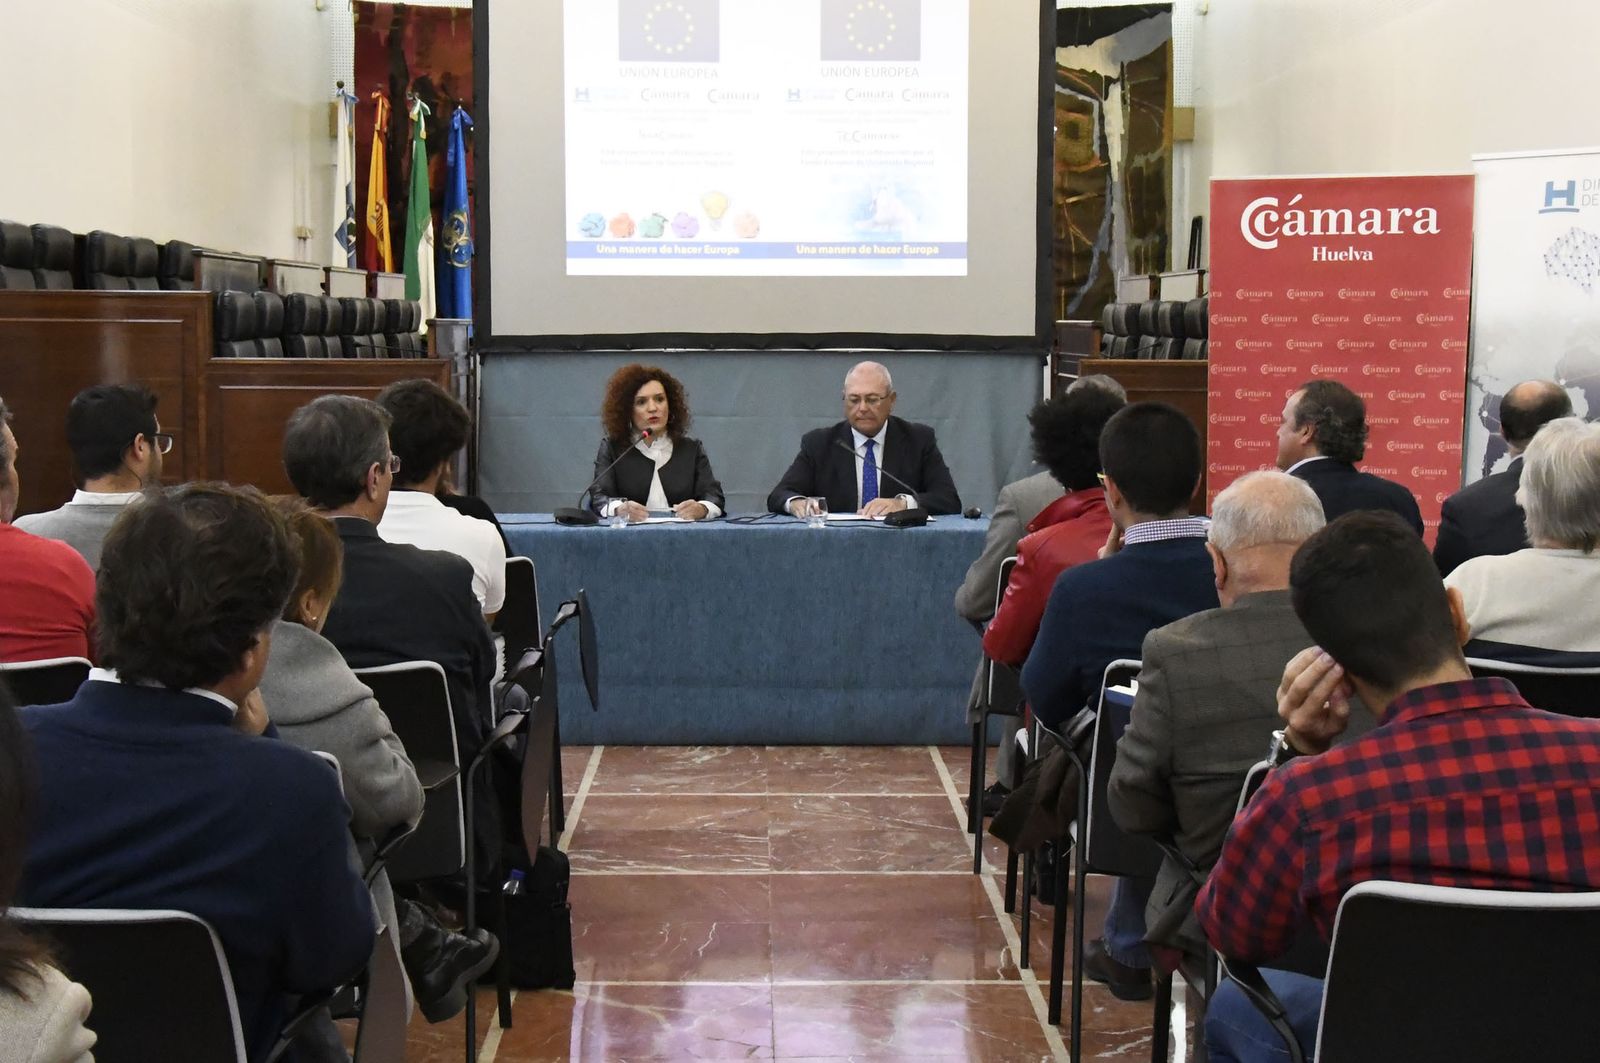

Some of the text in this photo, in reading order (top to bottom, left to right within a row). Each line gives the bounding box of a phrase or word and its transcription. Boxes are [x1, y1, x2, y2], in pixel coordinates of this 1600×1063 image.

[663, 67, 719, 79] EUROPEA
[820, 65, 920, 77] UNIÓN EUROPEA
[1582, 178, 1600, 191] DI
[597, 244, 617, 253] Una
[659, 244, 672, 253] de
[673, 244, 702, 253] hacer
[703, 244, 740, 255] Europa
[796, 244, 816, 253] Una
[859, 244, 872, 253] de
[873, 244, 901, 253] hacer
[902, 244, 940, 255] Europa
[1312, 246, 1374, 262] Huelva
